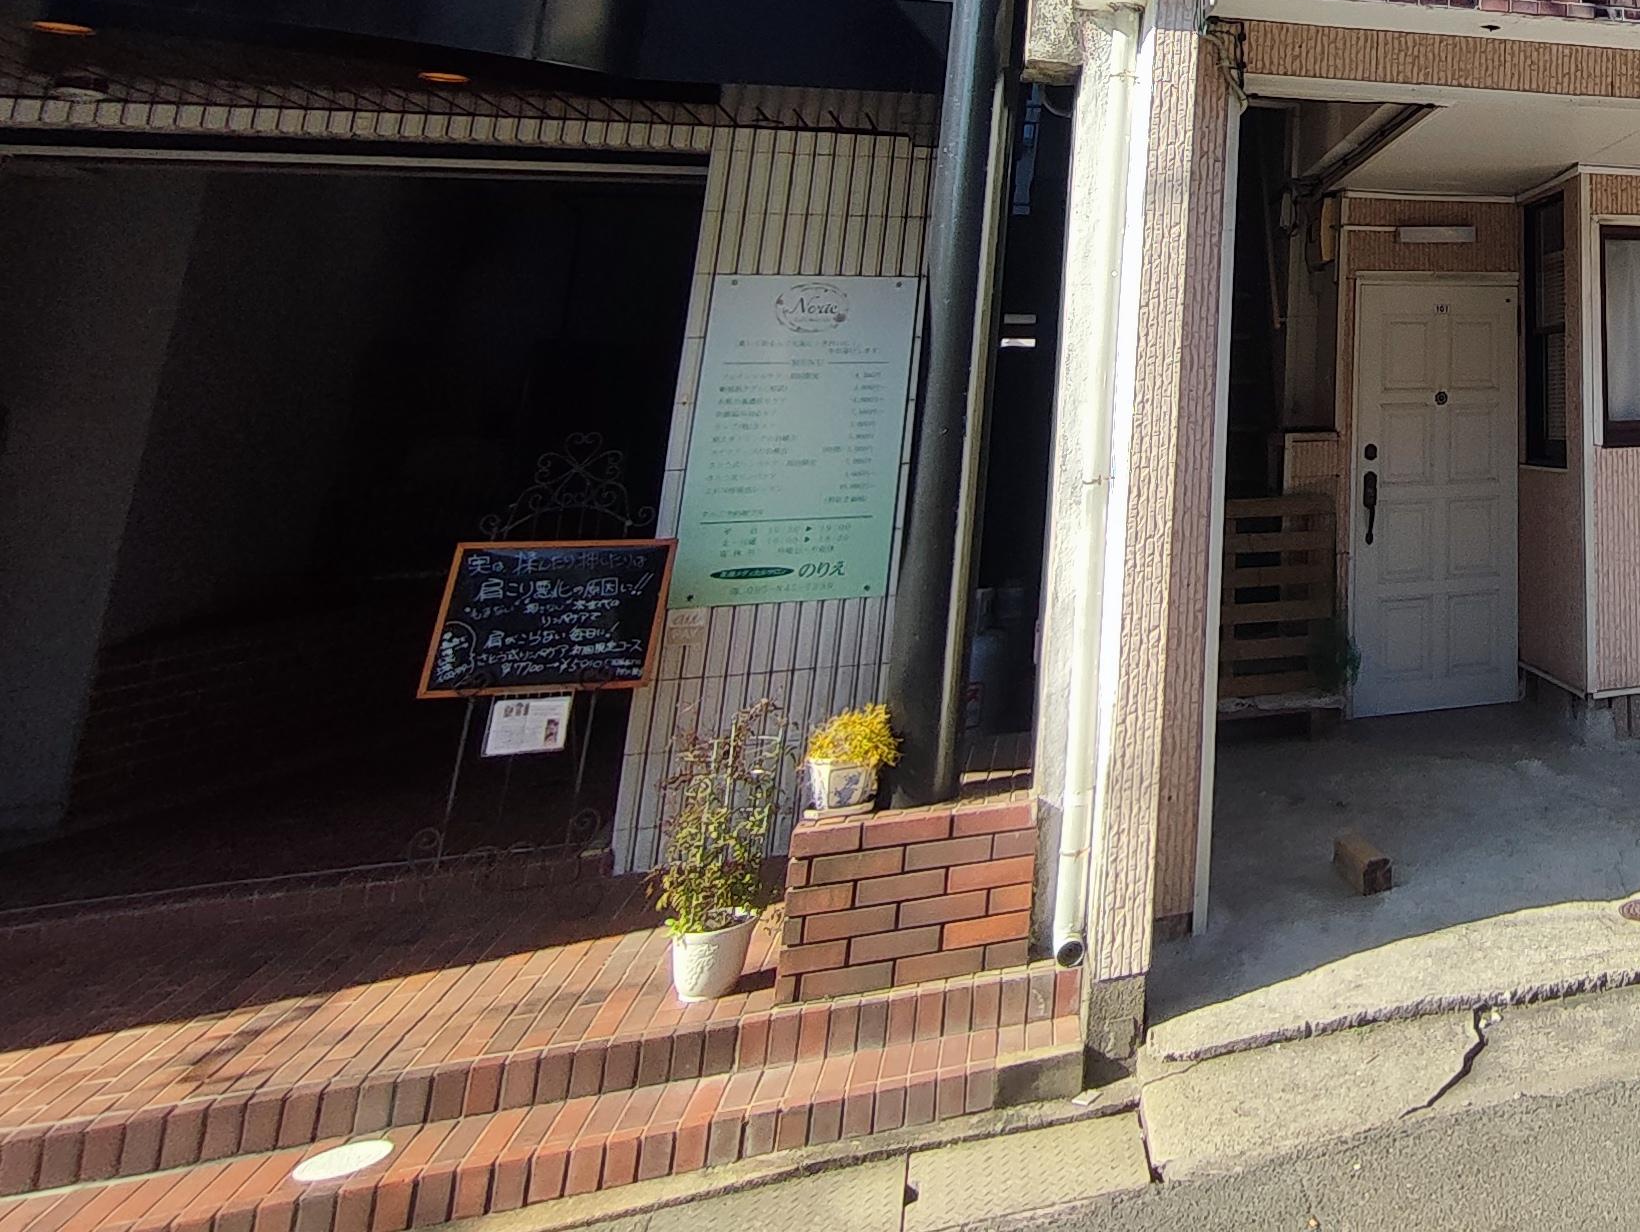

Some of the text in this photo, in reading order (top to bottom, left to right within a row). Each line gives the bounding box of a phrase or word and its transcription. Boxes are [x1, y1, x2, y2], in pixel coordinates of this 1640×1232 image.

[1436, 305, 1449, 313] 101
[798, 560, 846, 579] のりえ
